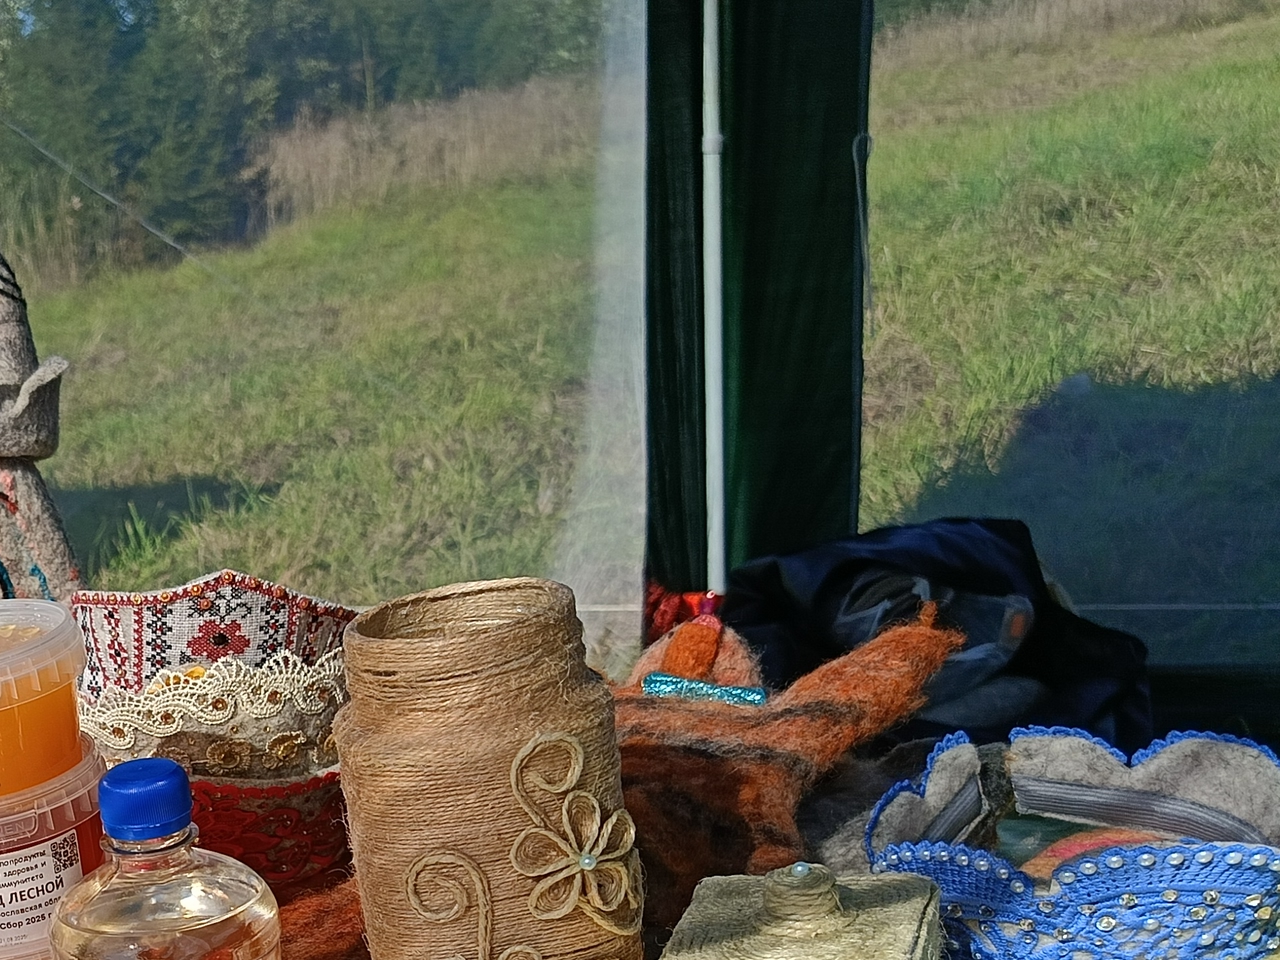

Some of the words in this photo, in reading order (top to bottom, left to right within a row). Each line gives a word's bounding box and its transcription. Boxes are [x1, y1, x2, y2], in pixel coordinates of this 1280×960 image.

[3, 864, 39, 878] здоровья
[8, 875, 65, 904] ЛЕСНОЙ
[0, 919, 24, 930] Сбор
[25, 913, 46, 926] 2025
